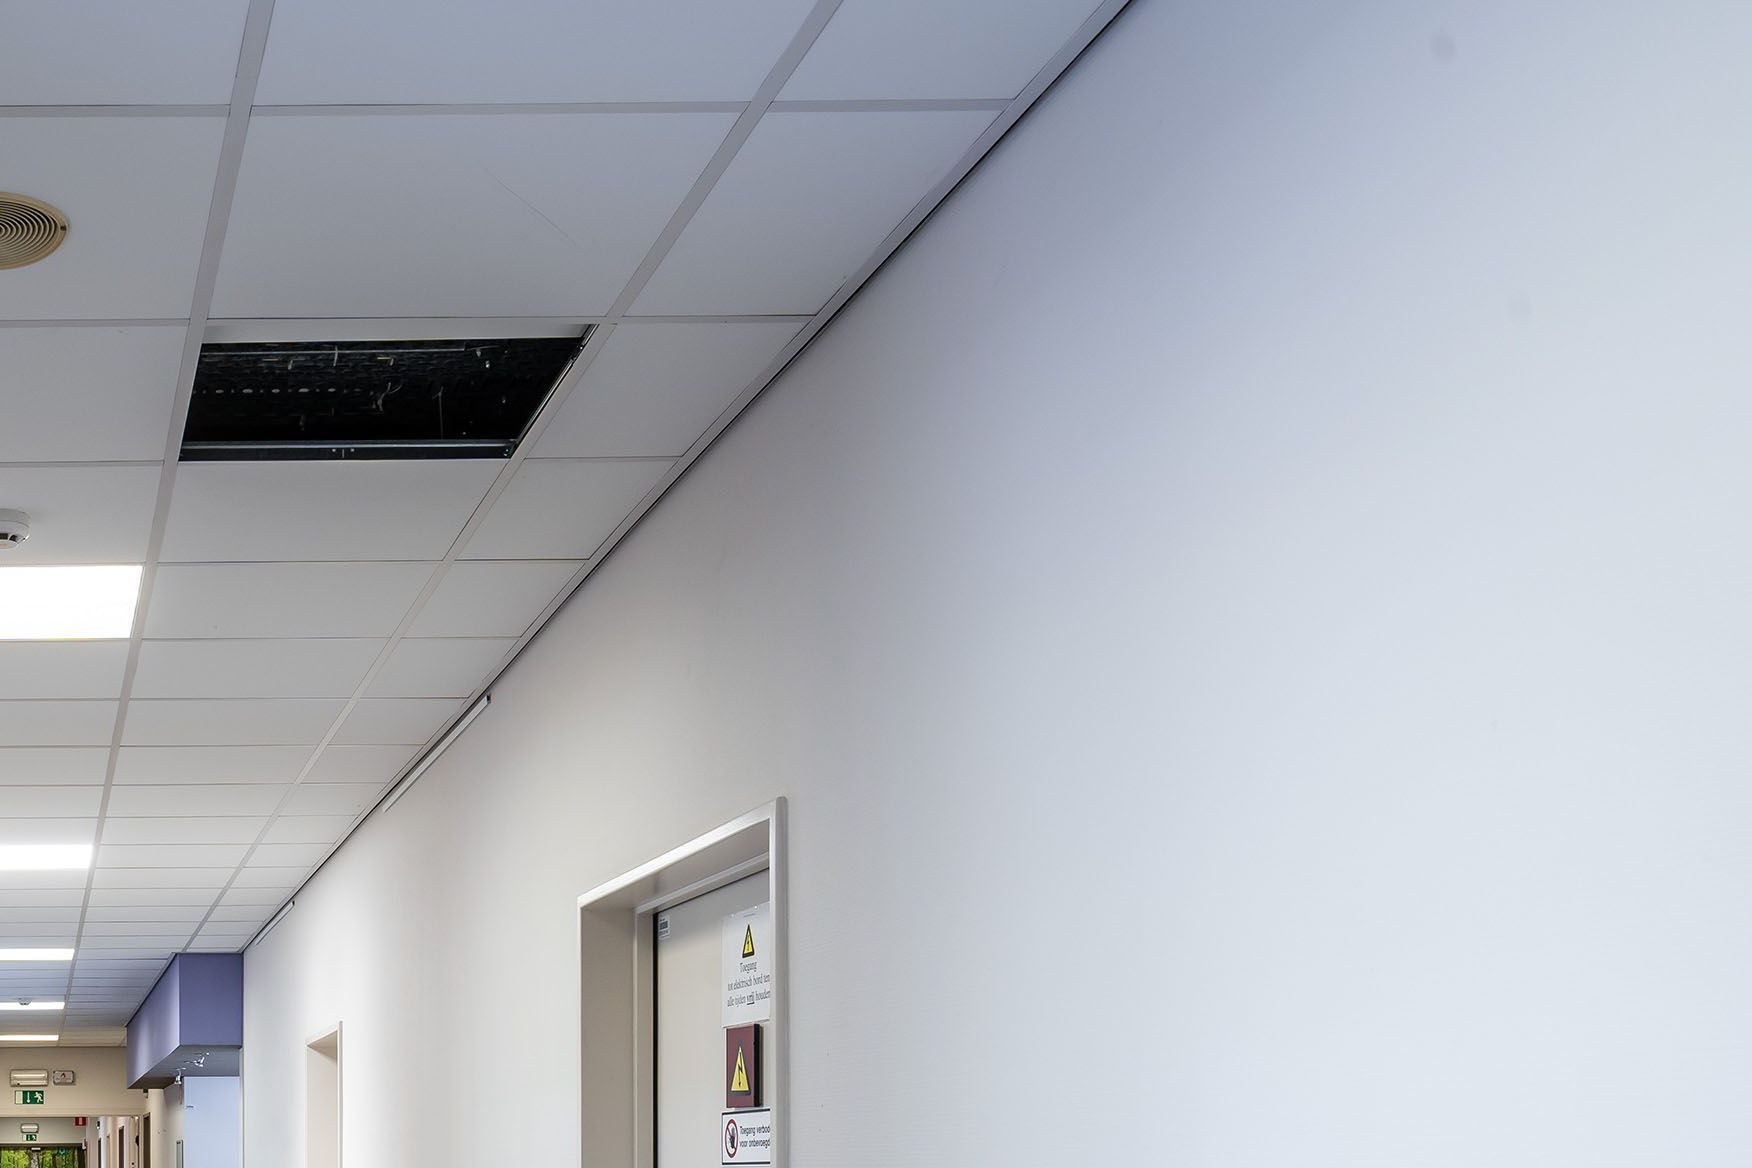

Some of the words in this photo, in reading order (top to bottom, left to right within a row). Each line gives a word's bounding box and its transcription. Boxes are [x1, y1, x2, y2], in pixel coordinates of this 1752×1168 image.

[740, 961, 757, 973] Toegang
[734, 976, 752, 990] elektrisch
[753, 974, 762, 985] bord
[740, 1125, 755, 1136] Toegang
